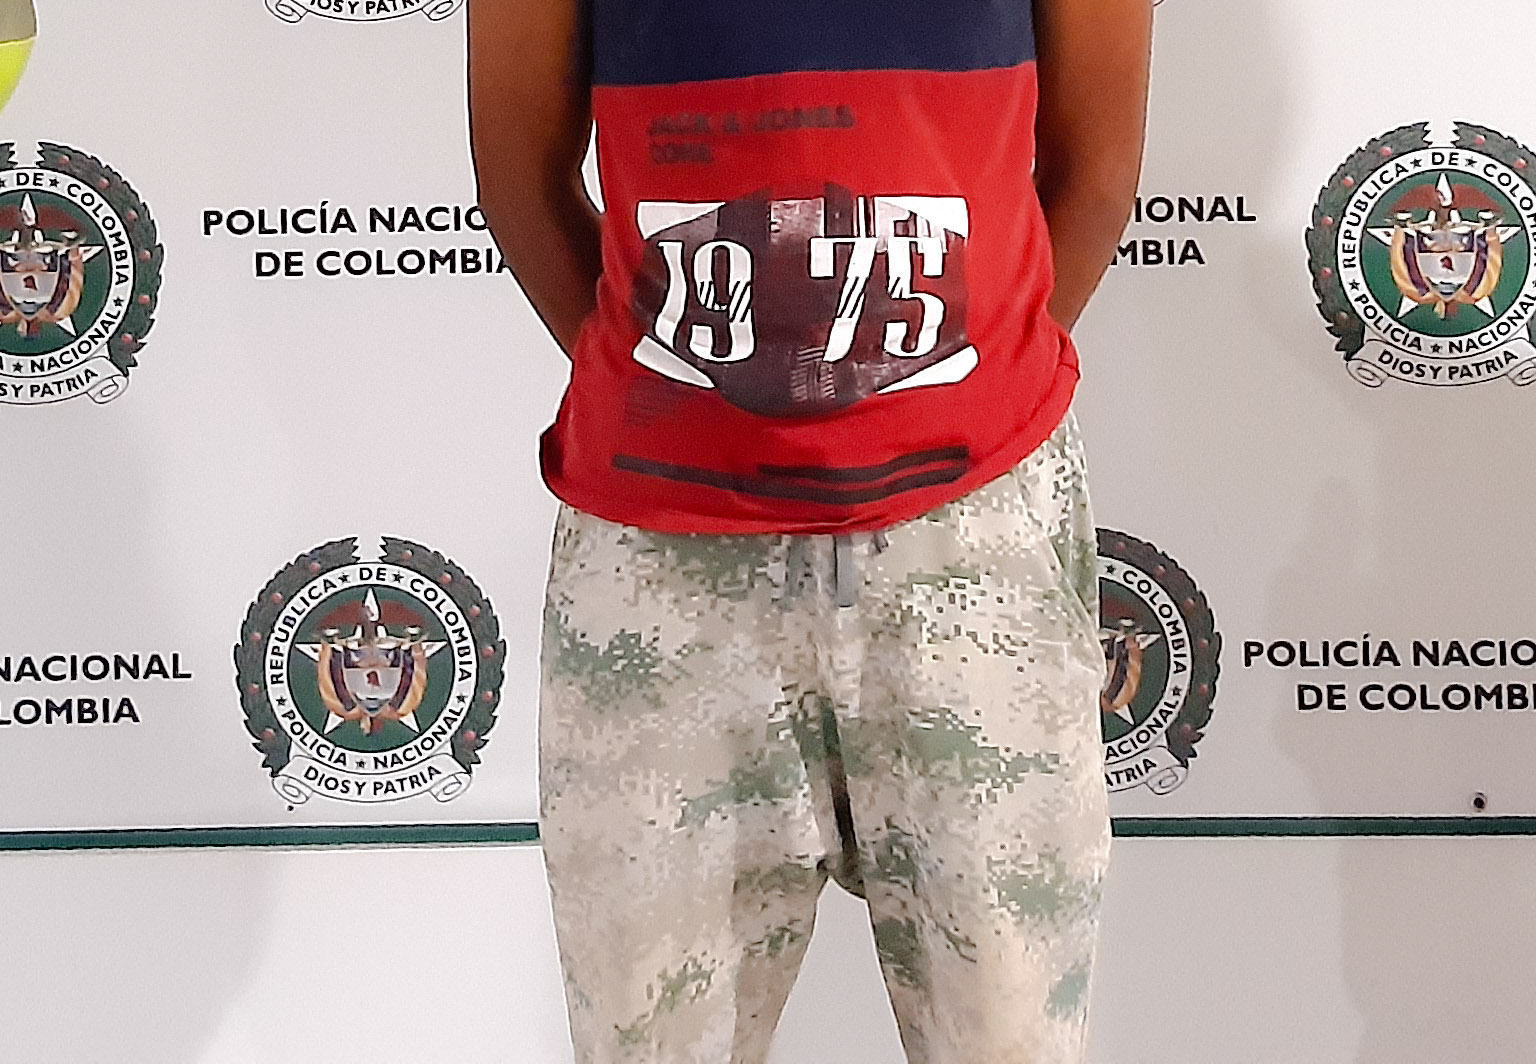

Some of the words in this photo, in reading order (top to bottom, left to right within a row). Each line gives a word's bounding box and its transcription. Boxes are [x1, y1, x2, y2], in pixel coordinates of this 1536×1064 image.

[1431, 152, 1460, 166] DE
[204, 201, 357, 235] POLICÍA
[370, 205, 487, 234] NACIO
[1135, 195, 1257, 223] IONAL
[256, 251, 303, 277] DE
[654, 239, 756, 363] 19
[808, 236, 945, 363] 75
[1448, 349, 1518, 380] PATRIA
[359, 567, 387, 581] DE
[410, 578, 472, 682] COLOMBIA
[1244, 633, 1401, 667] POLICÍA
[1297, 684, 1346, 710] DE
[374, 707, 463, 769] NACIONAL
[373, 765, 441, 795] PATRIA
